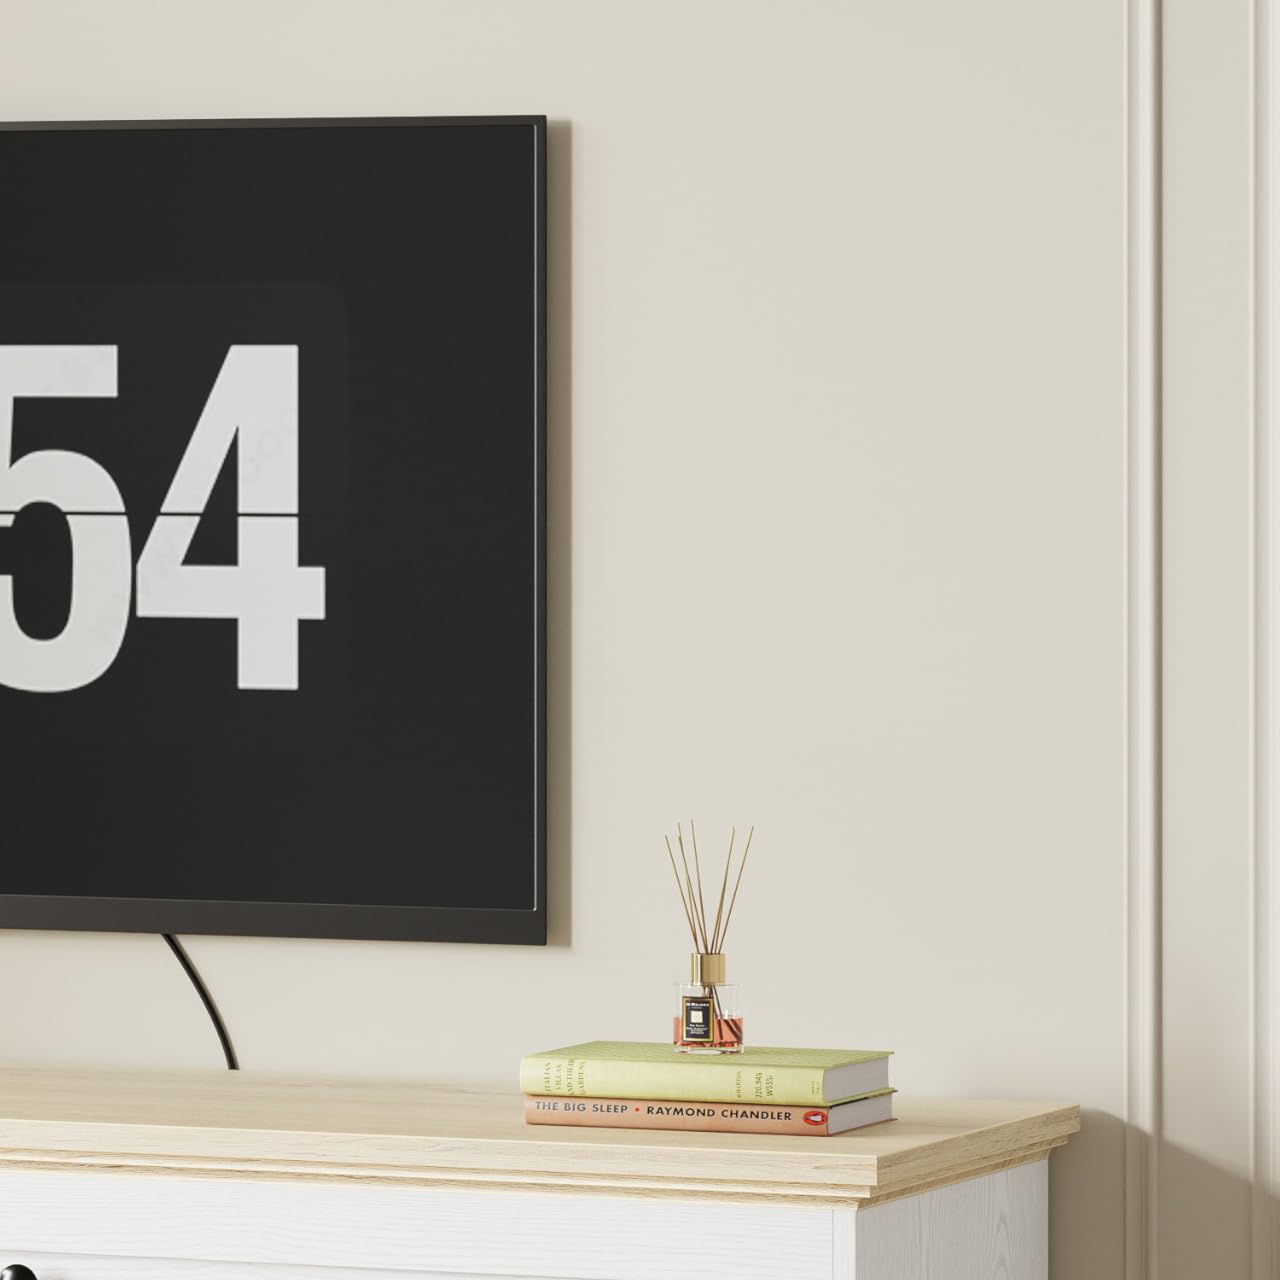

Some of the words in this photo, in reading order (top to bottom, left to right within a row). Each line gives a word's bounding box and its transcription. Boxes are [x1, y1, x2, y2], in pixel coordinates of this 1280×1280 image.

[544, 1062, 552, 1092] ITALIAN
[535, 1101, 560, 1111] THE
[564, 1102, 587, 1112] BIG
[592, 1103, 628, 1115] SLEEP
[646, 1105, 716, 1118] RAYMOND
[721, 1108, 793, 1121] CHANDLER
